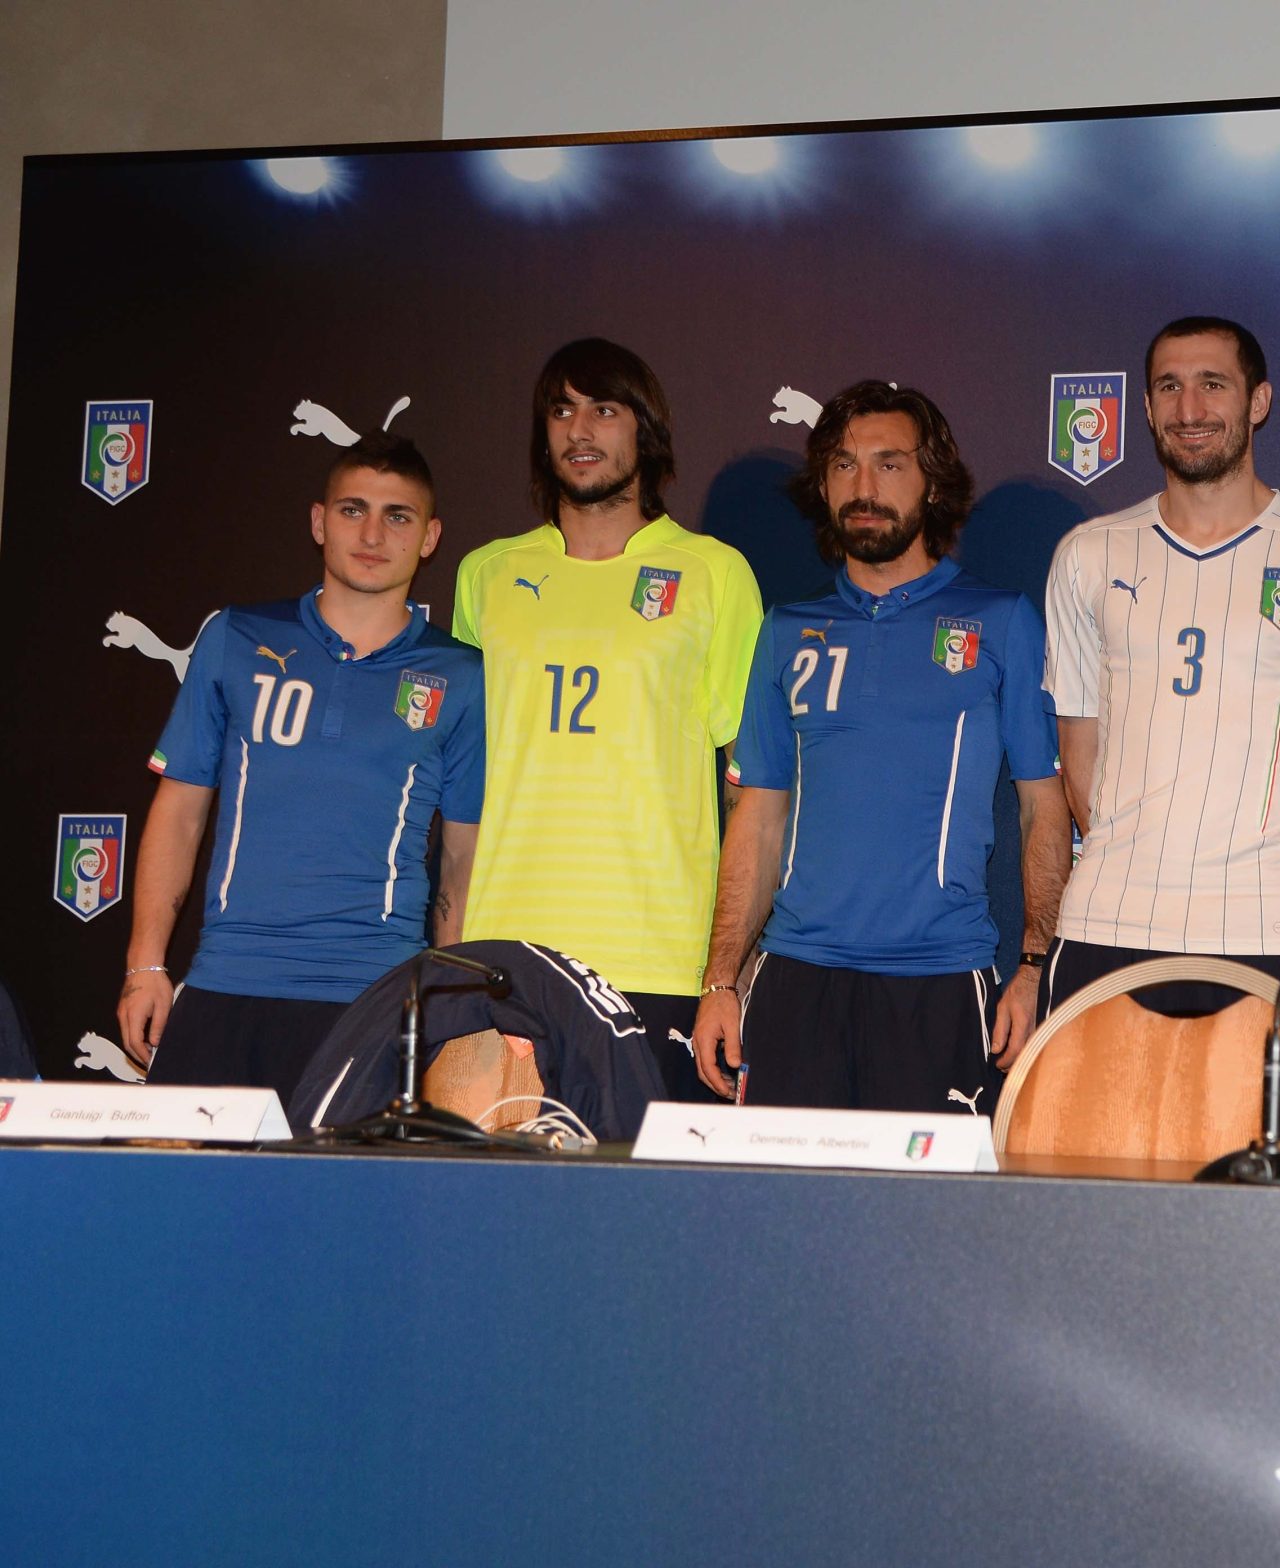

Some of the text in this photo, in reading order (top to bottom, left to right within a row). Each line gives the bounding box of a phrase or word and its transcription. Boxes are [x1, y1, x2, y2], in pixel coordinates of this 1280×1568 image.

[1062, 383, 1113, 396] ITALIA
[95, 409, 142, 421] ITALIA
[1078, 421, 1097, 429] FIGC
[643, 569, 676, 580] ITALIA
[942, 620, 976, 631] ITALIA
[1172, 626, 1206, 697] 3
[407, 674, 440, 688] ITALIA
[790, 646, 849, 717] 21
[544, 663, 600, 734] 12
[252, 673, 314, 747] 10
[69, 824, 115, 835] ITALIA
[49, 1108, 151, 1122] Gianluigi Buffon
